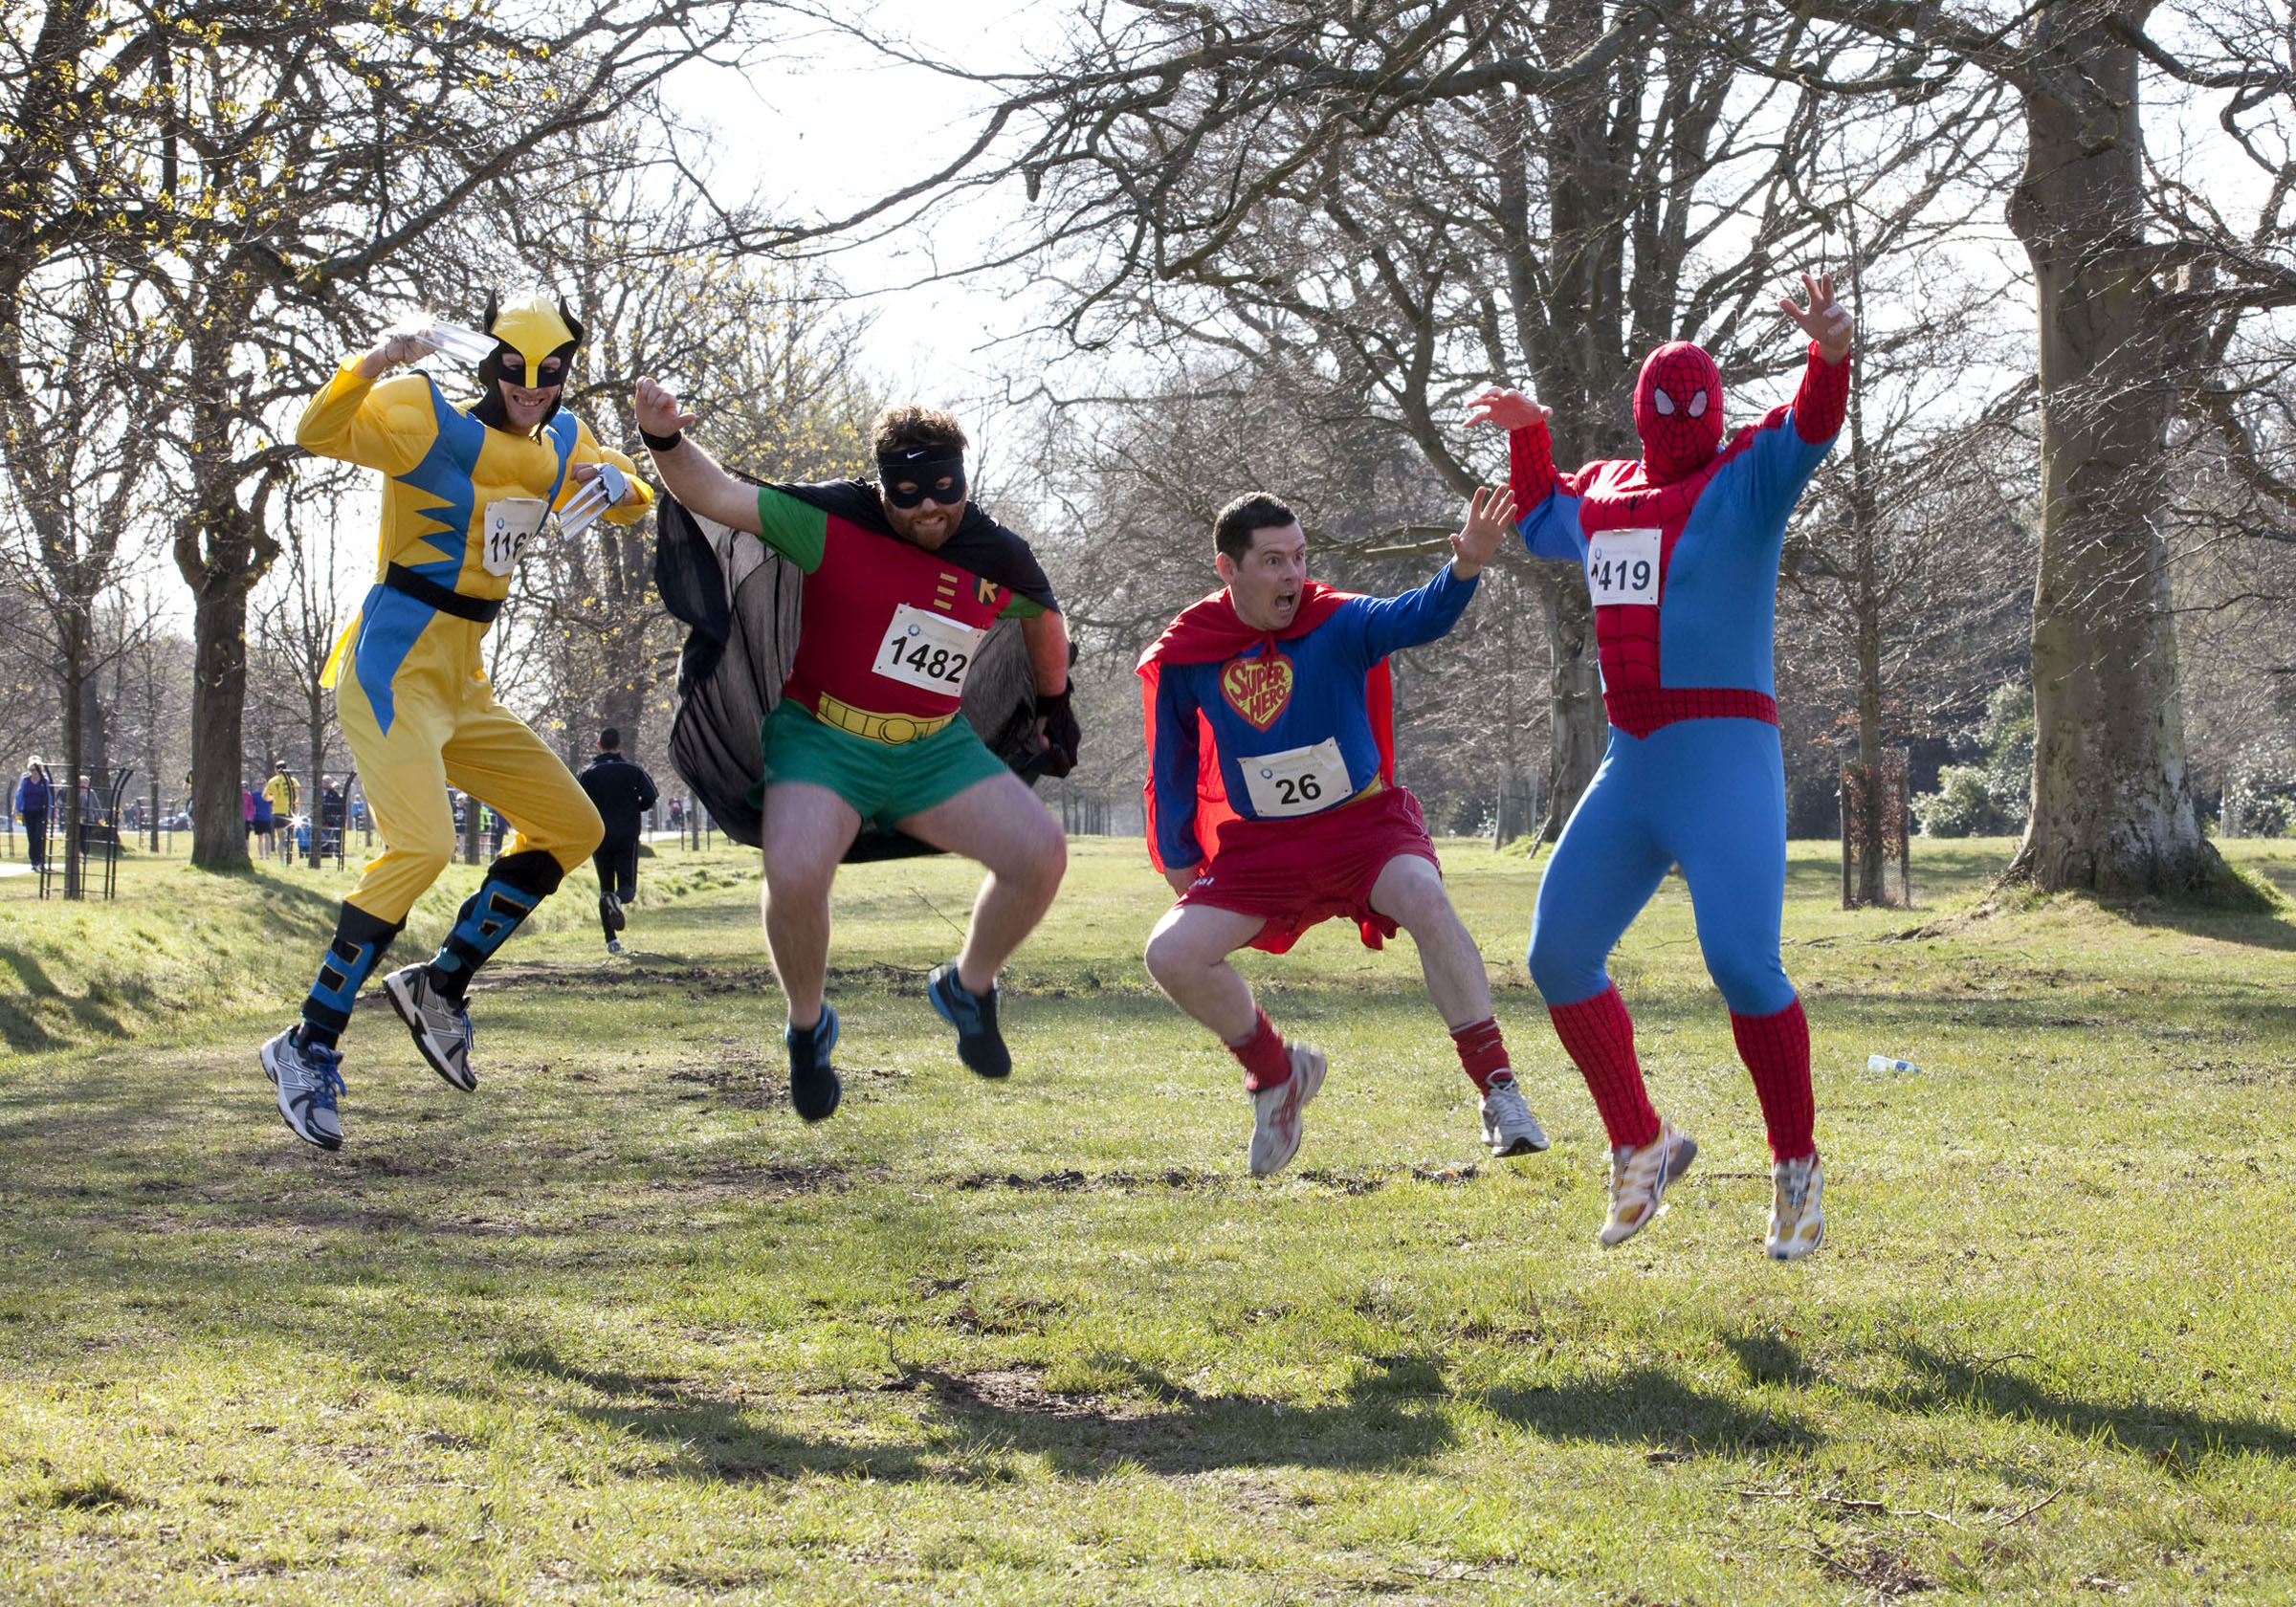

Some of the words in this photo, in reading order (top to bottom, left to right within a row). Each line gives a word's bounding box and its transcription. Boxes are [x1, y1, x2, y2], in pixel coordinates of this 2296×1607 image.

[891, 635, 967, 683] 1482
[1229, 663, 1286, 702] SUPER
[1249, 684, 1287, 724] HERO
[1275, 774, 1321, 804] 26
